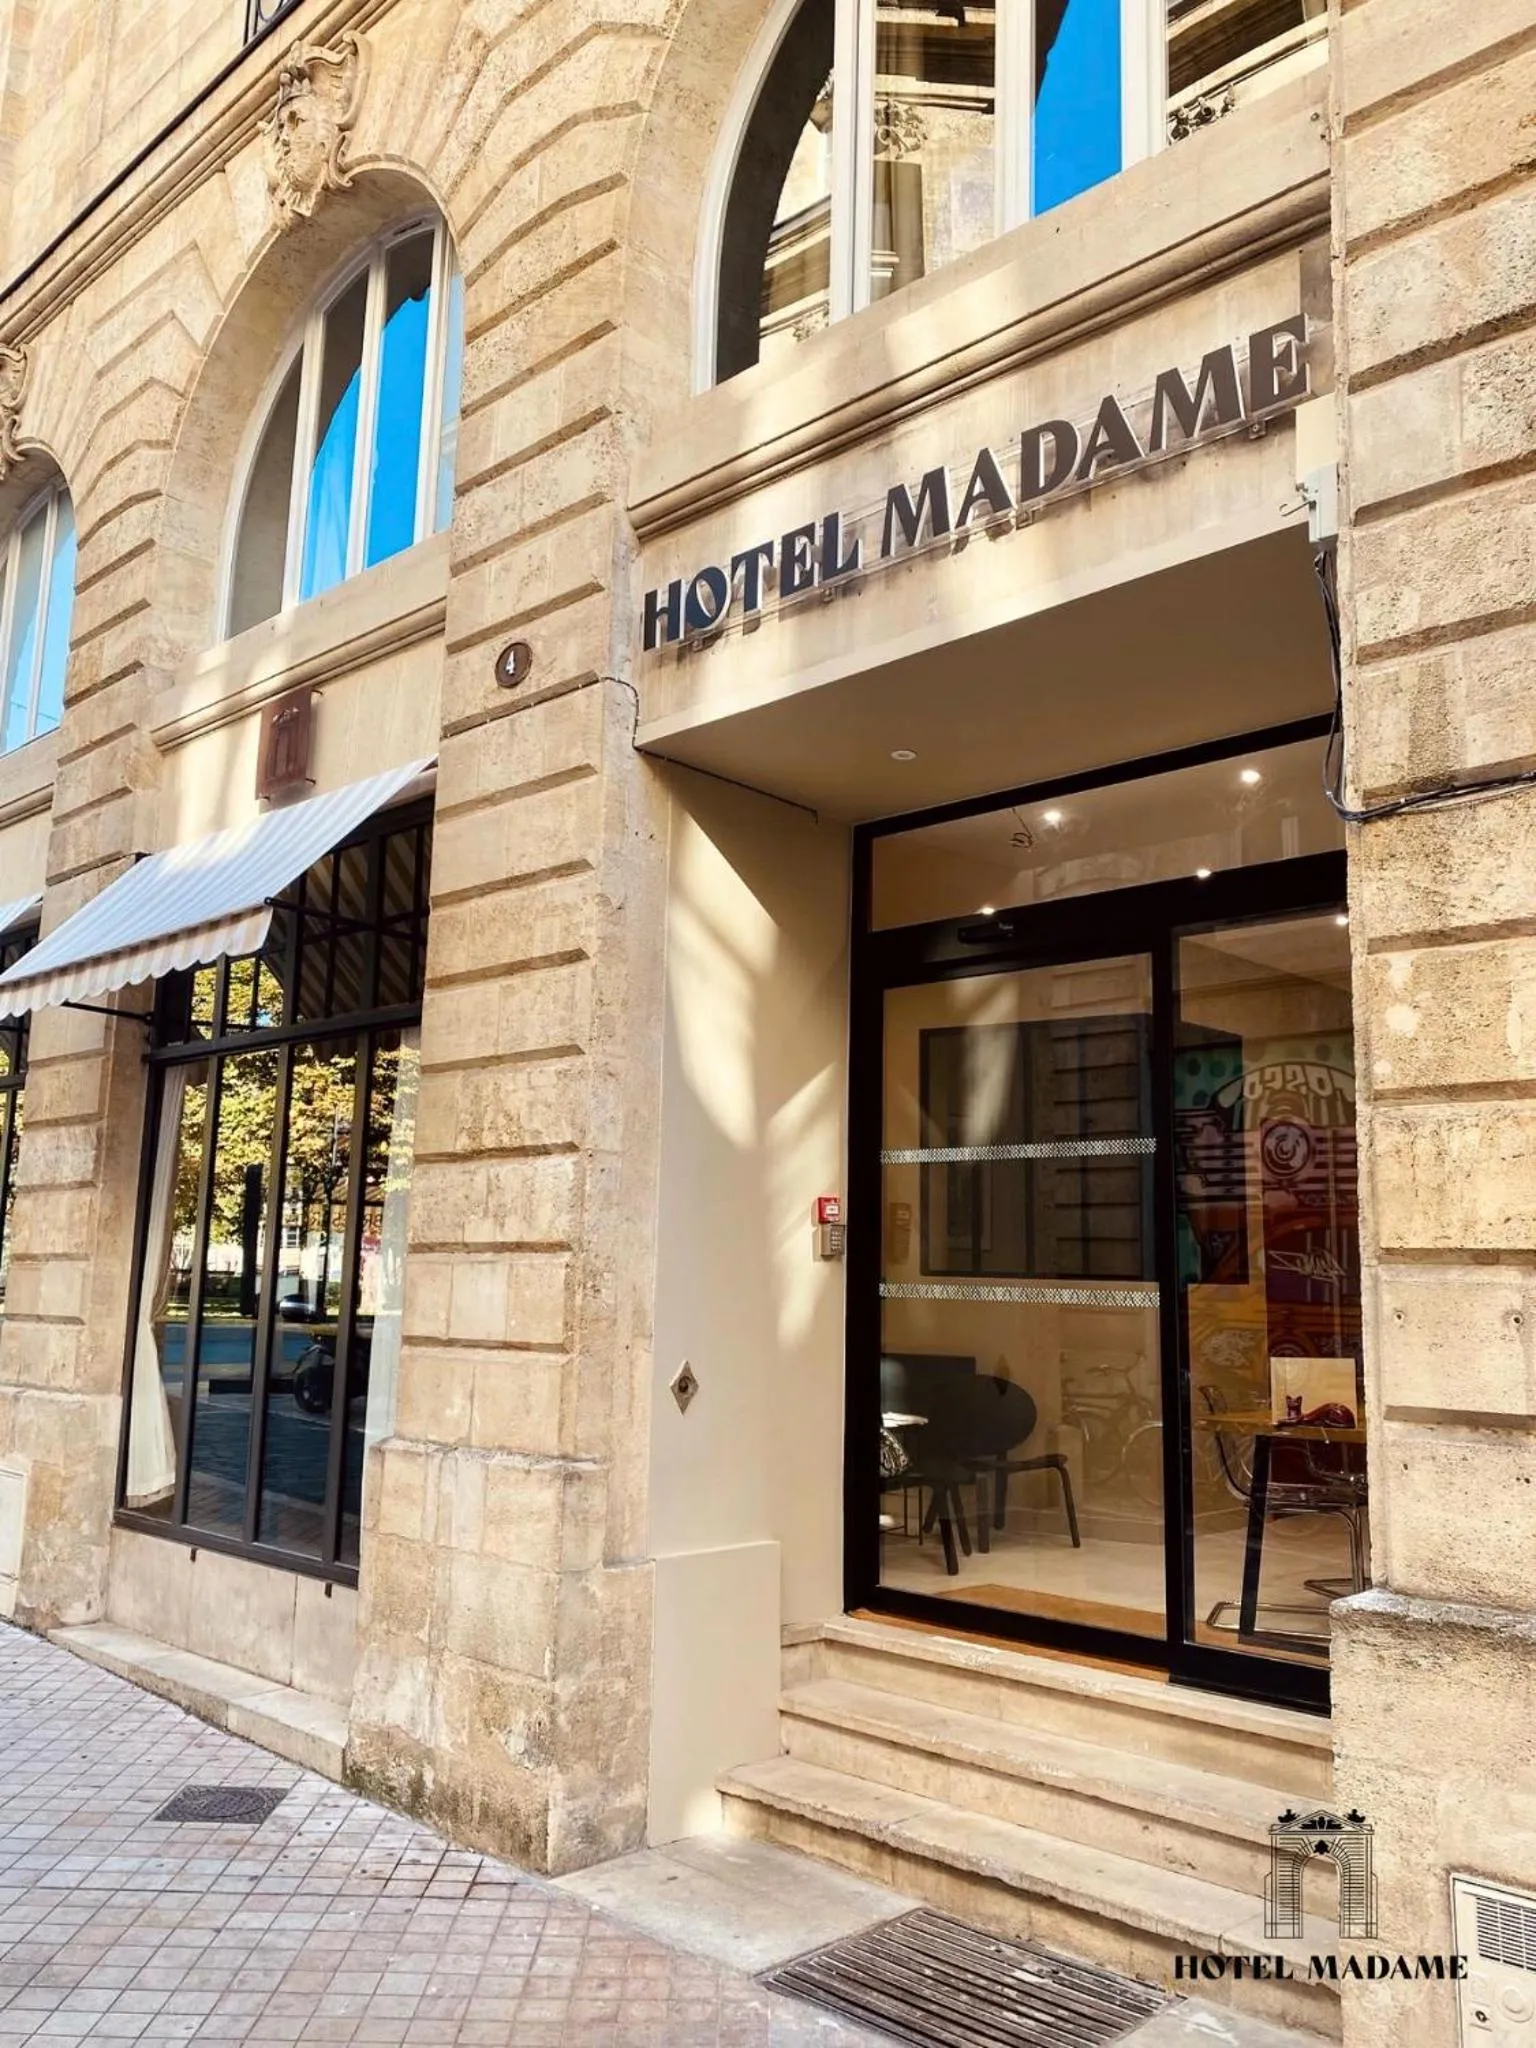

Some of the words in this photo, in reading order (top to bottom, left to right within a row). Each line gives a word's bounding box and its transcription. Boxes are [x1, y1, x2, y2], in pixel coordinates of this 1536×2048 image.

[643, 511, 863, 650] HOTEL
[881, 313, 1311, 558] MADAME
[506, 650, 515, 675] 4
